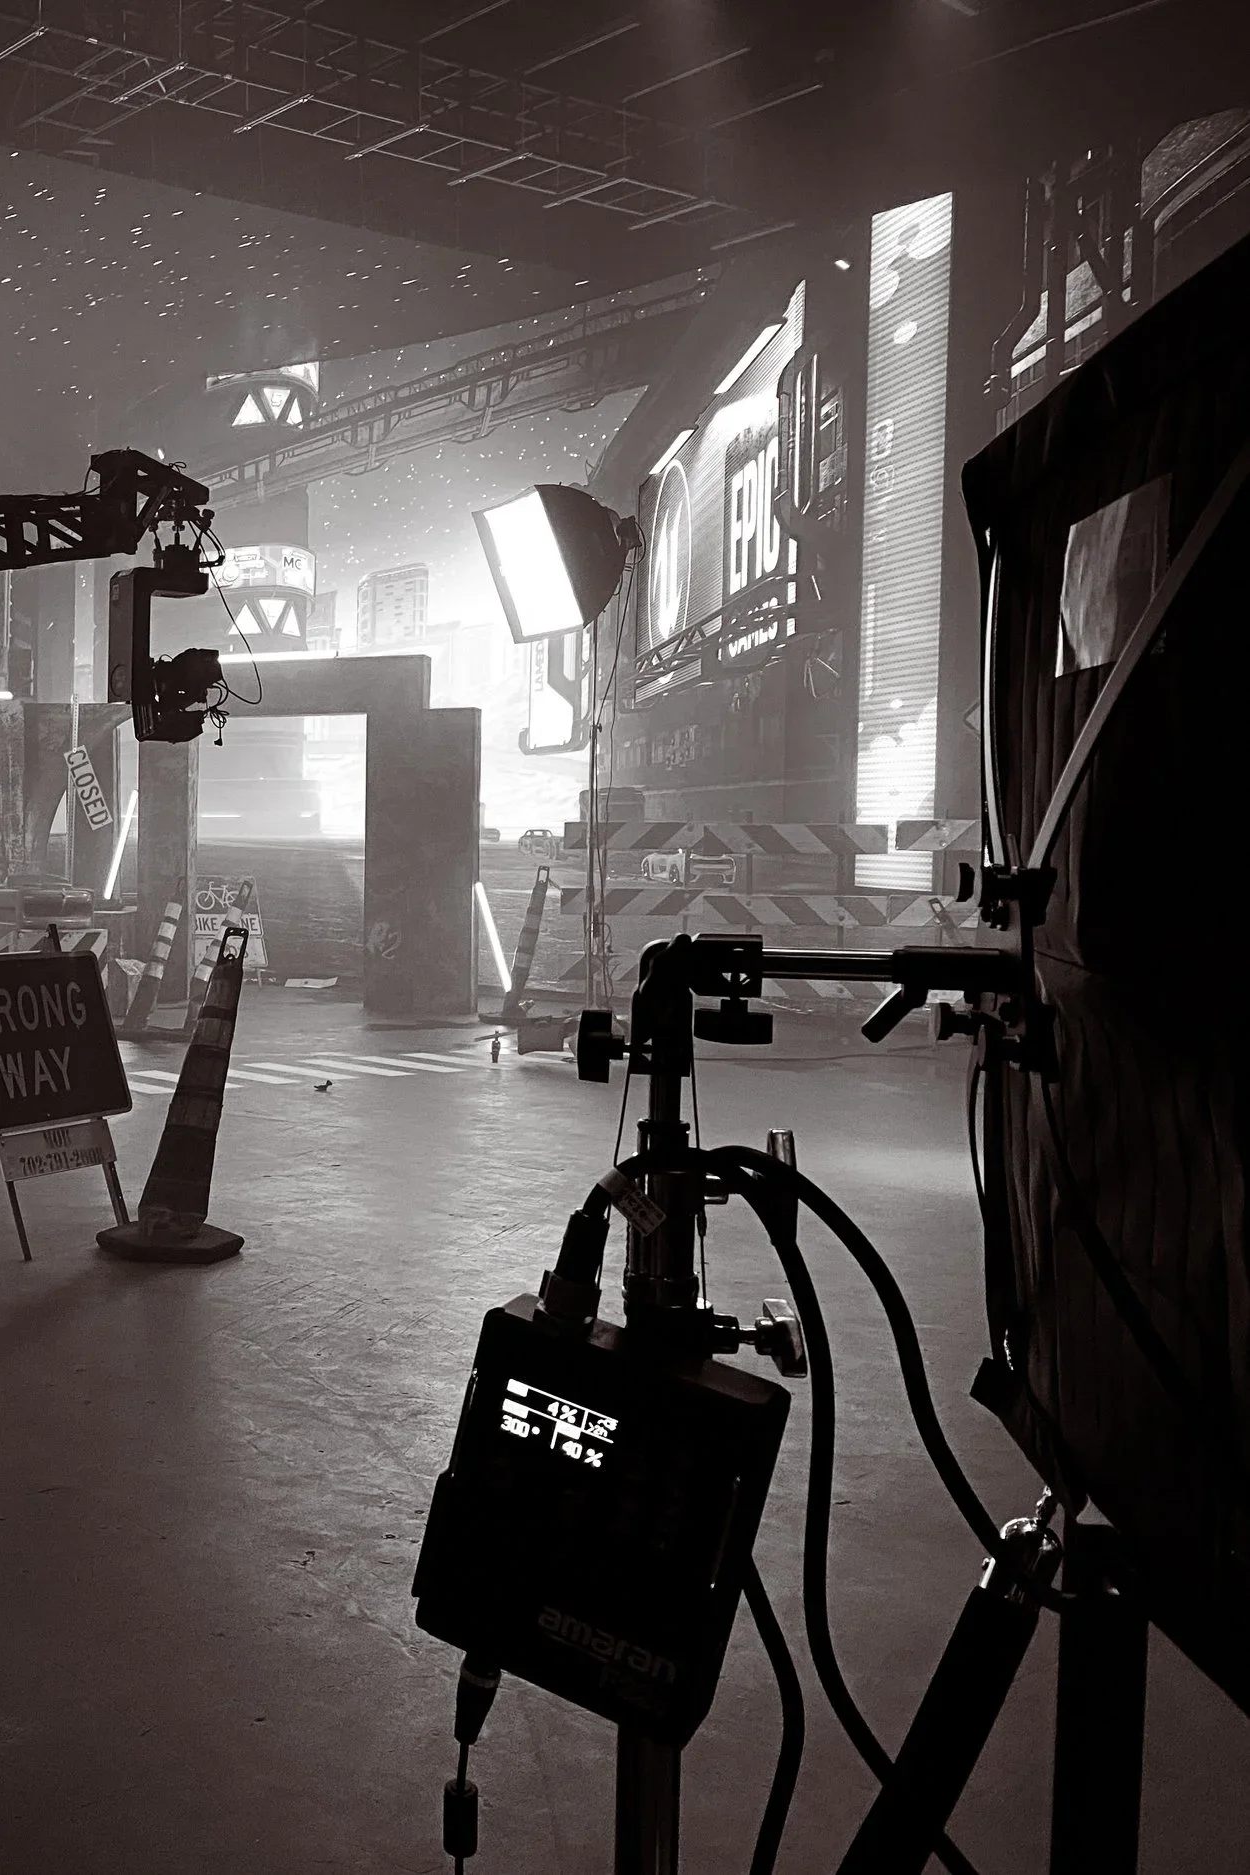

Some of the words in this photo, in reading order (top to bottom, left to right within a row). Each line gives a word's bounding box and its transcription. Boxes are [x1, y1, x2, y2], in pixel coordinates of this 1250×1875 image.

[730, 437, 780, 595] EPIC
[67, 750, 109, 826] CLOSED
[536, 1604, 677, 1686] amaran
